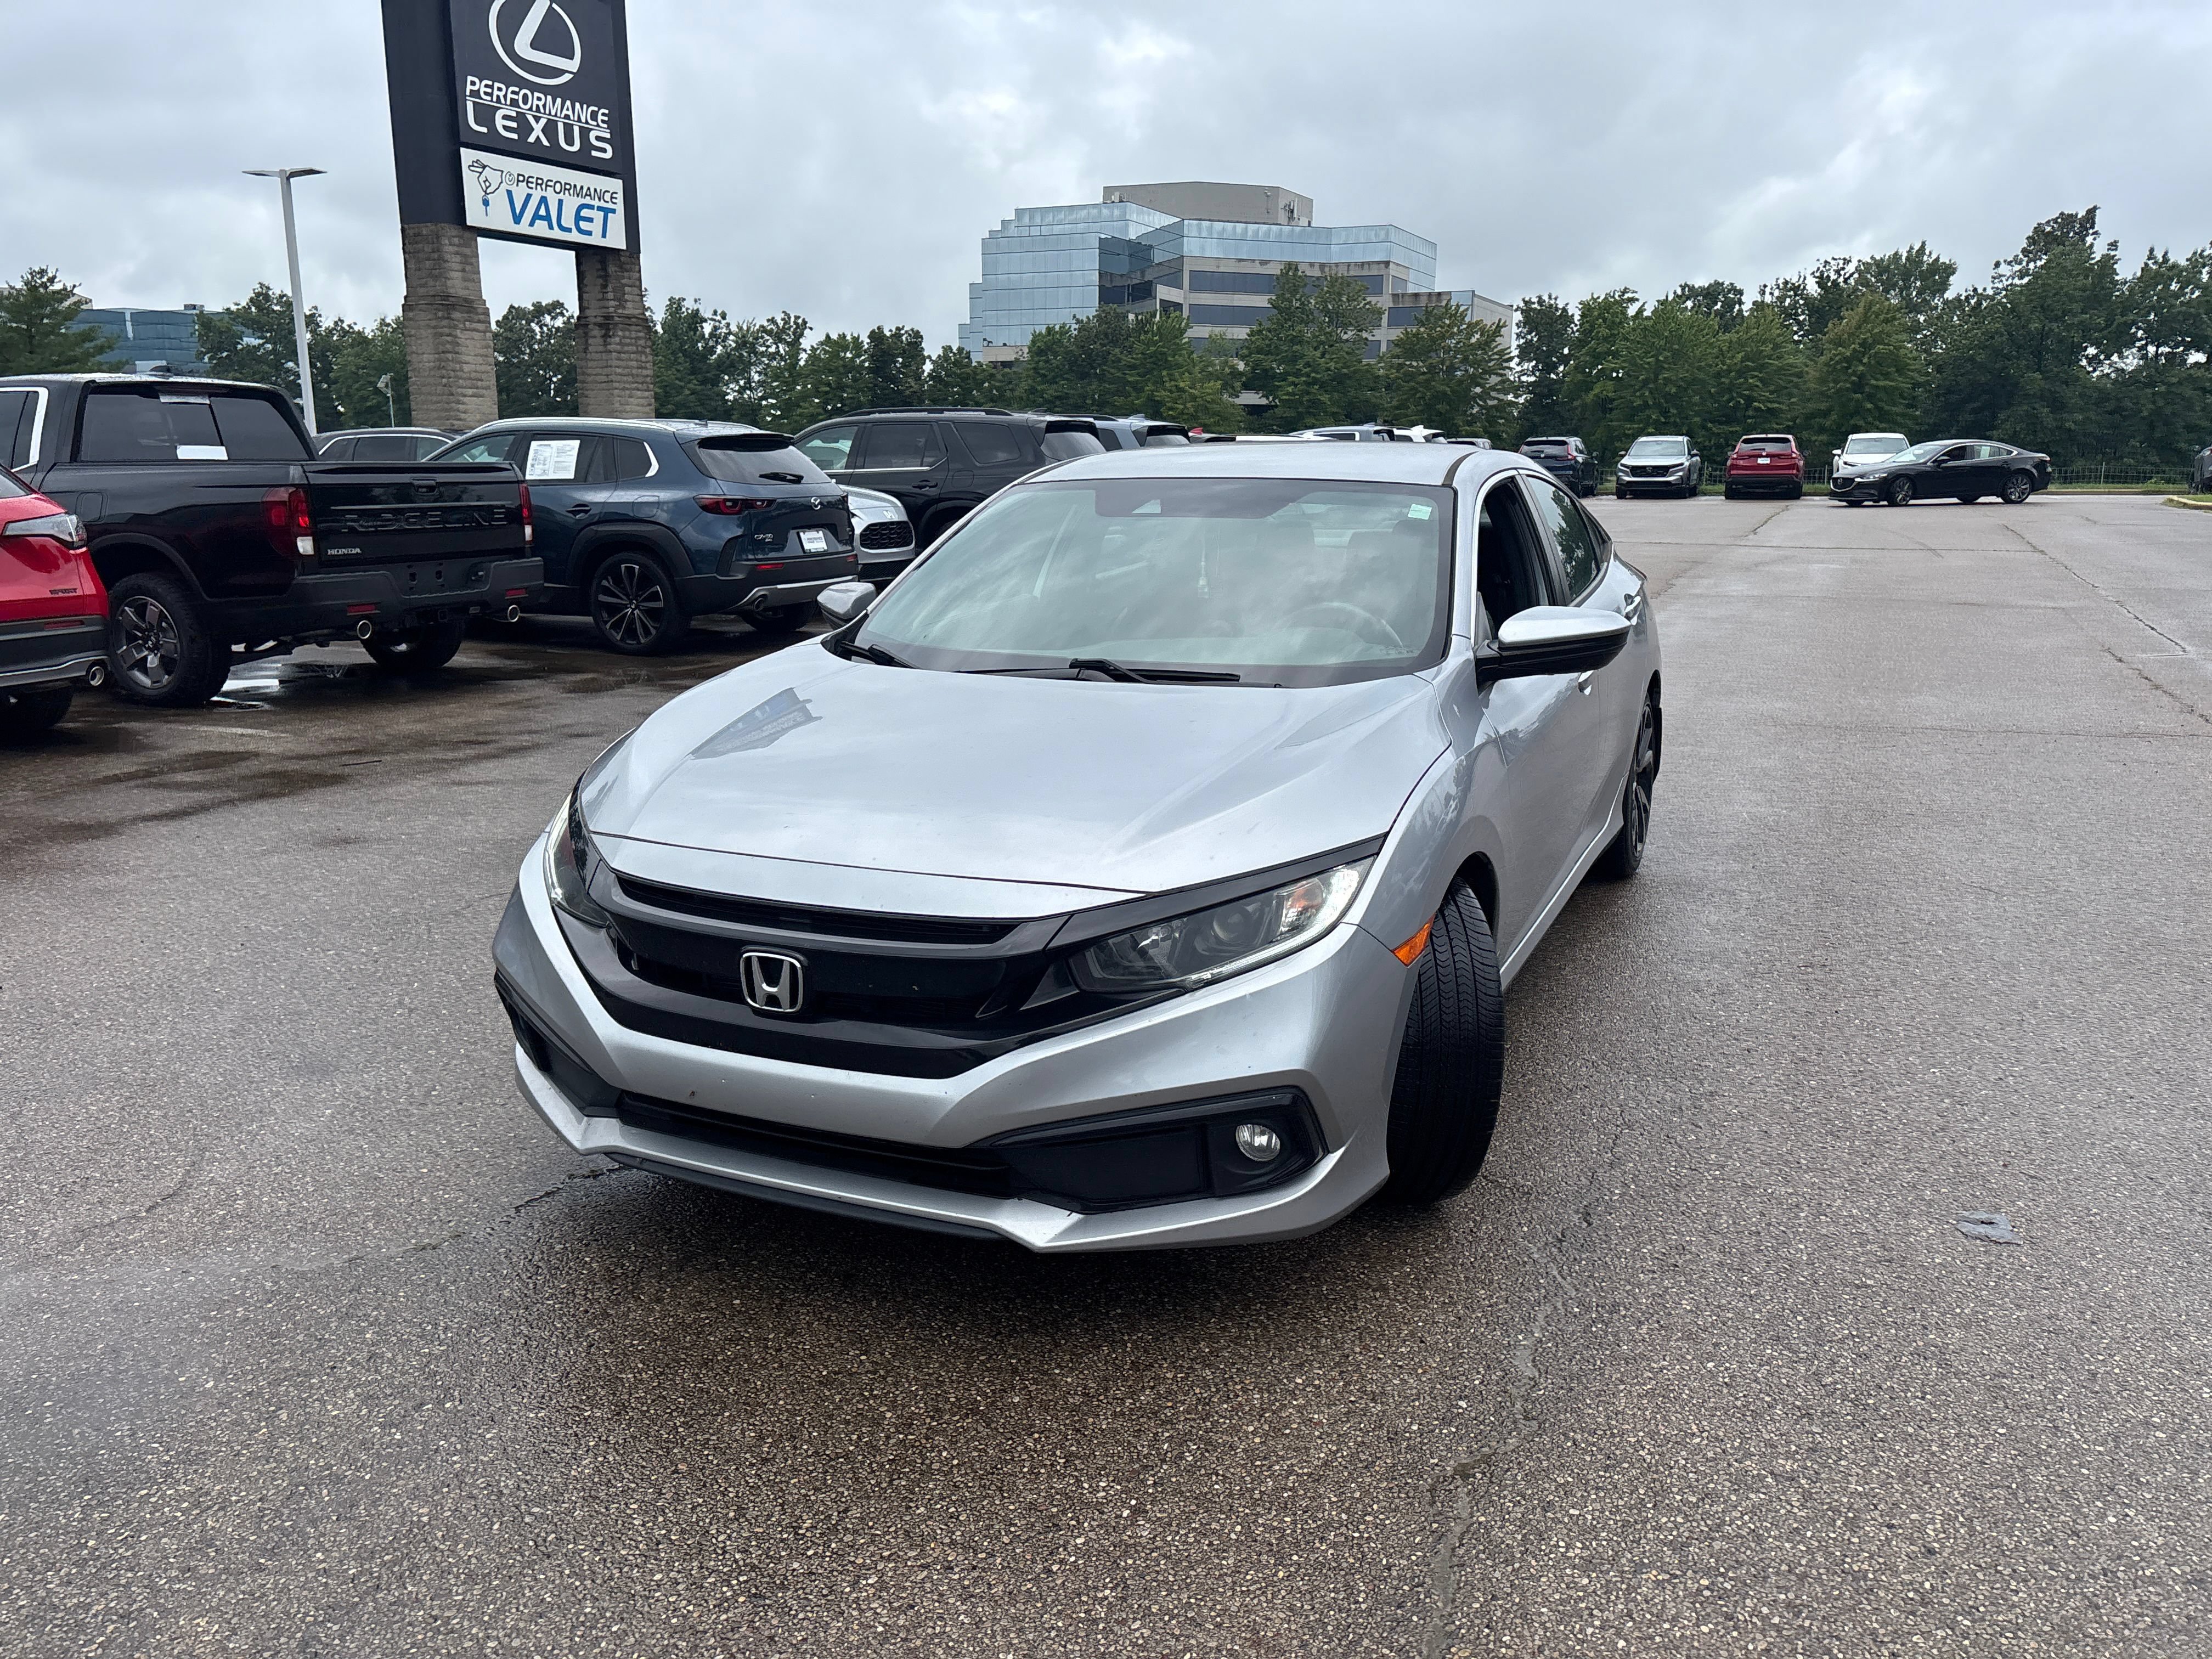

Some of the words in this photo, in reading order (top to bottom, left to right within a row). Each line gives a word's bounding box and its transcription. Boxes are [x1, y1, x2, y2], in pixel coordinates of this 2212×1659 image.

[466, 75, 609, 128] PERFORMANCE
[466, 100, 613, 159] LEXUS
[505, 189, 617, 239] VALET
[516, 173, 618, 205] PERFORMANCE
